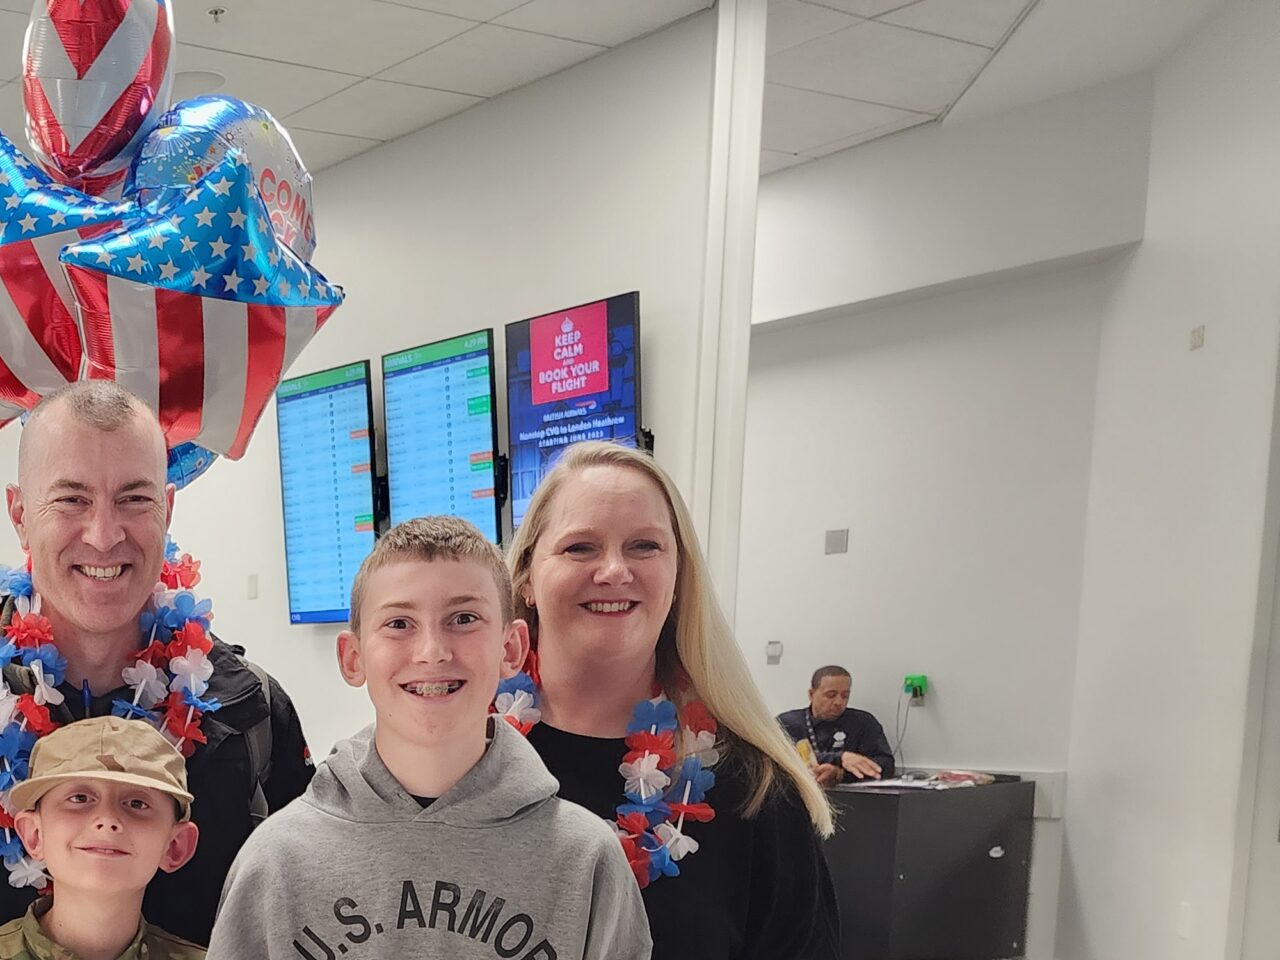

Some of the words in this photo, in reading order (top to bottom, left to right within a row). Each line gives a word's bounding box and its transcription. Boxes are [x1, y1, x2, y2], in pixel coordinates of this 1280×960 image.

[554, 331, 581, 347] KEEP
[553, 343, 584, 360] CALM
[538, 369, 568, 384] BOOK
[570, 360, 600, 376] YOUR
[551, 376, 587, 394] FLIGHT
[519, 429, 545, 440] Nonstop
[568, 420, 592, 431] London
[592, 416, 625, 428] Heathrow
